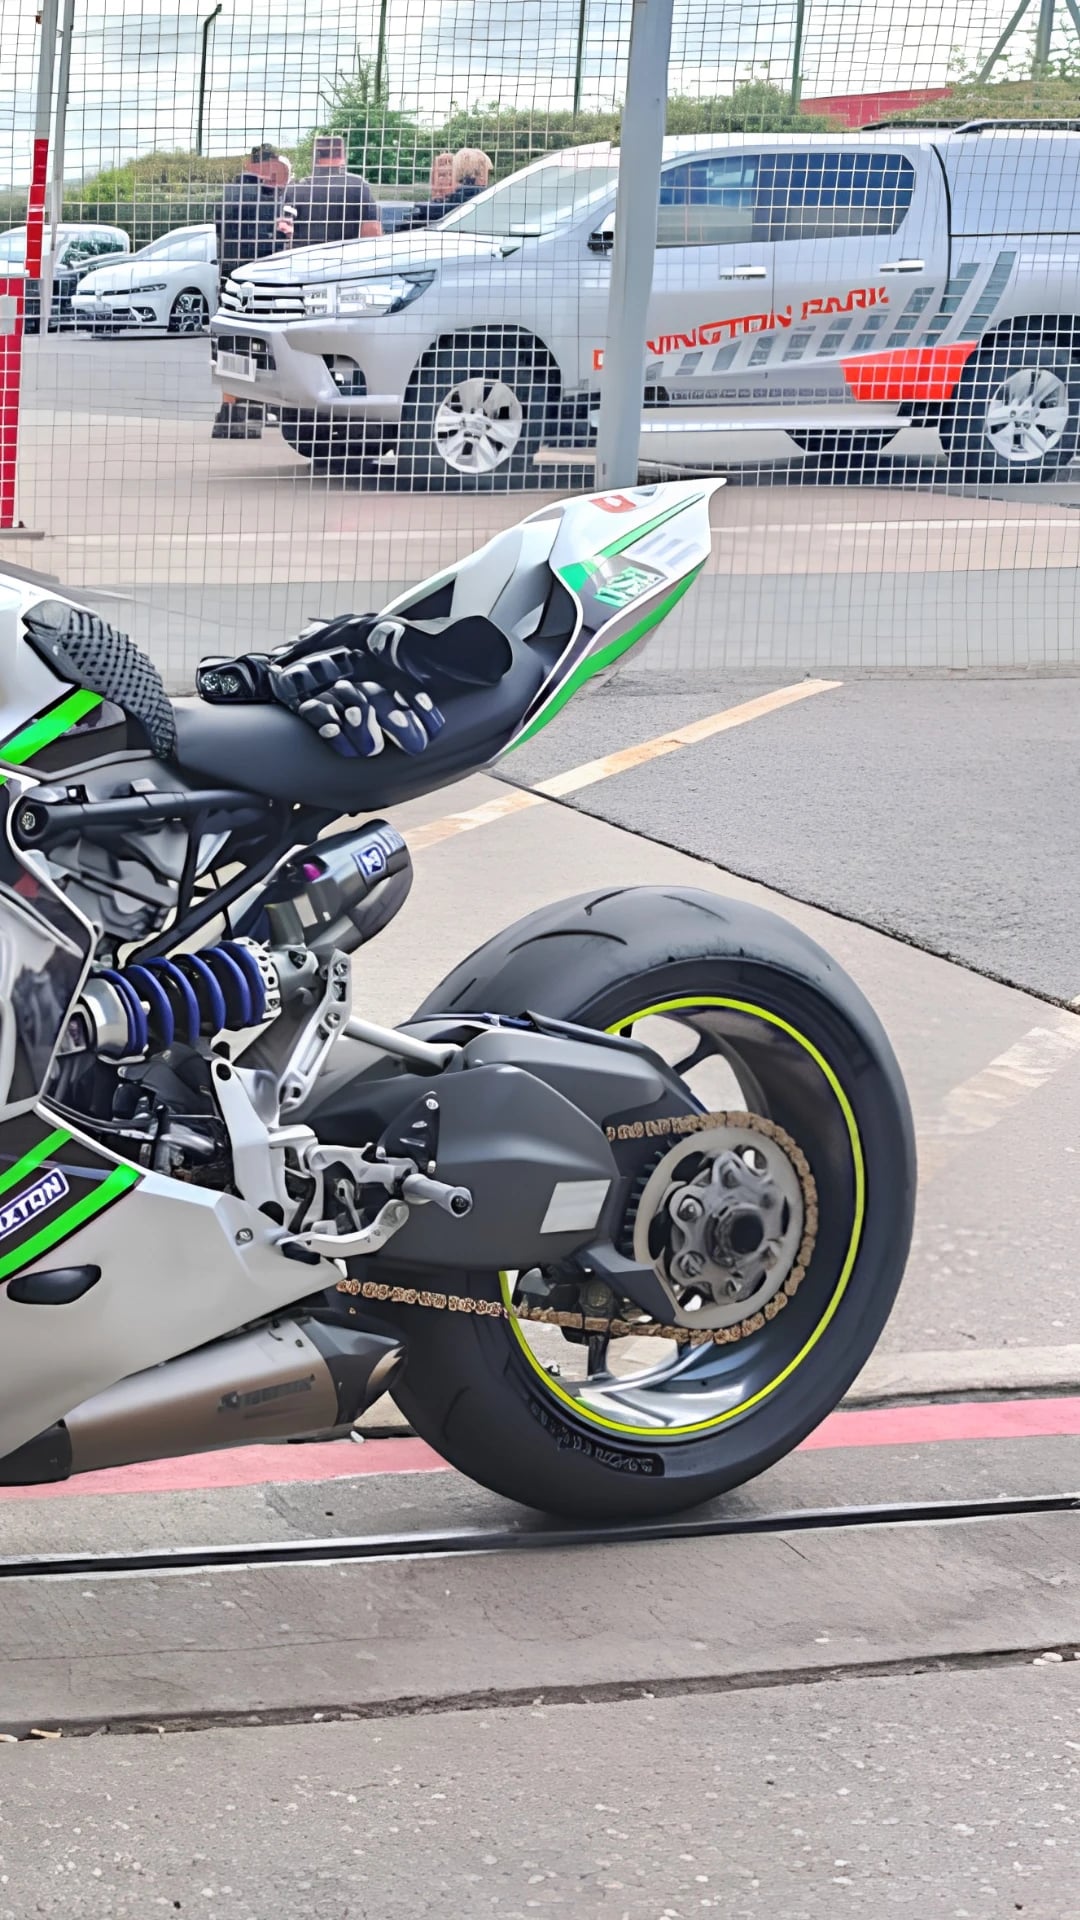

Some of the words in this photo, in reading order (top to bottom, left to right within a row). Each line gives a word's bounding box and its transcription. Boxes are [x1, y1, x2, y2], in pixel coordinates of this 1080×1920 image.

[593, 303, 792, 370] NINGTON
[801, 286, 889, 320] PARK
[0, 1175, 62, 1233] XTON
